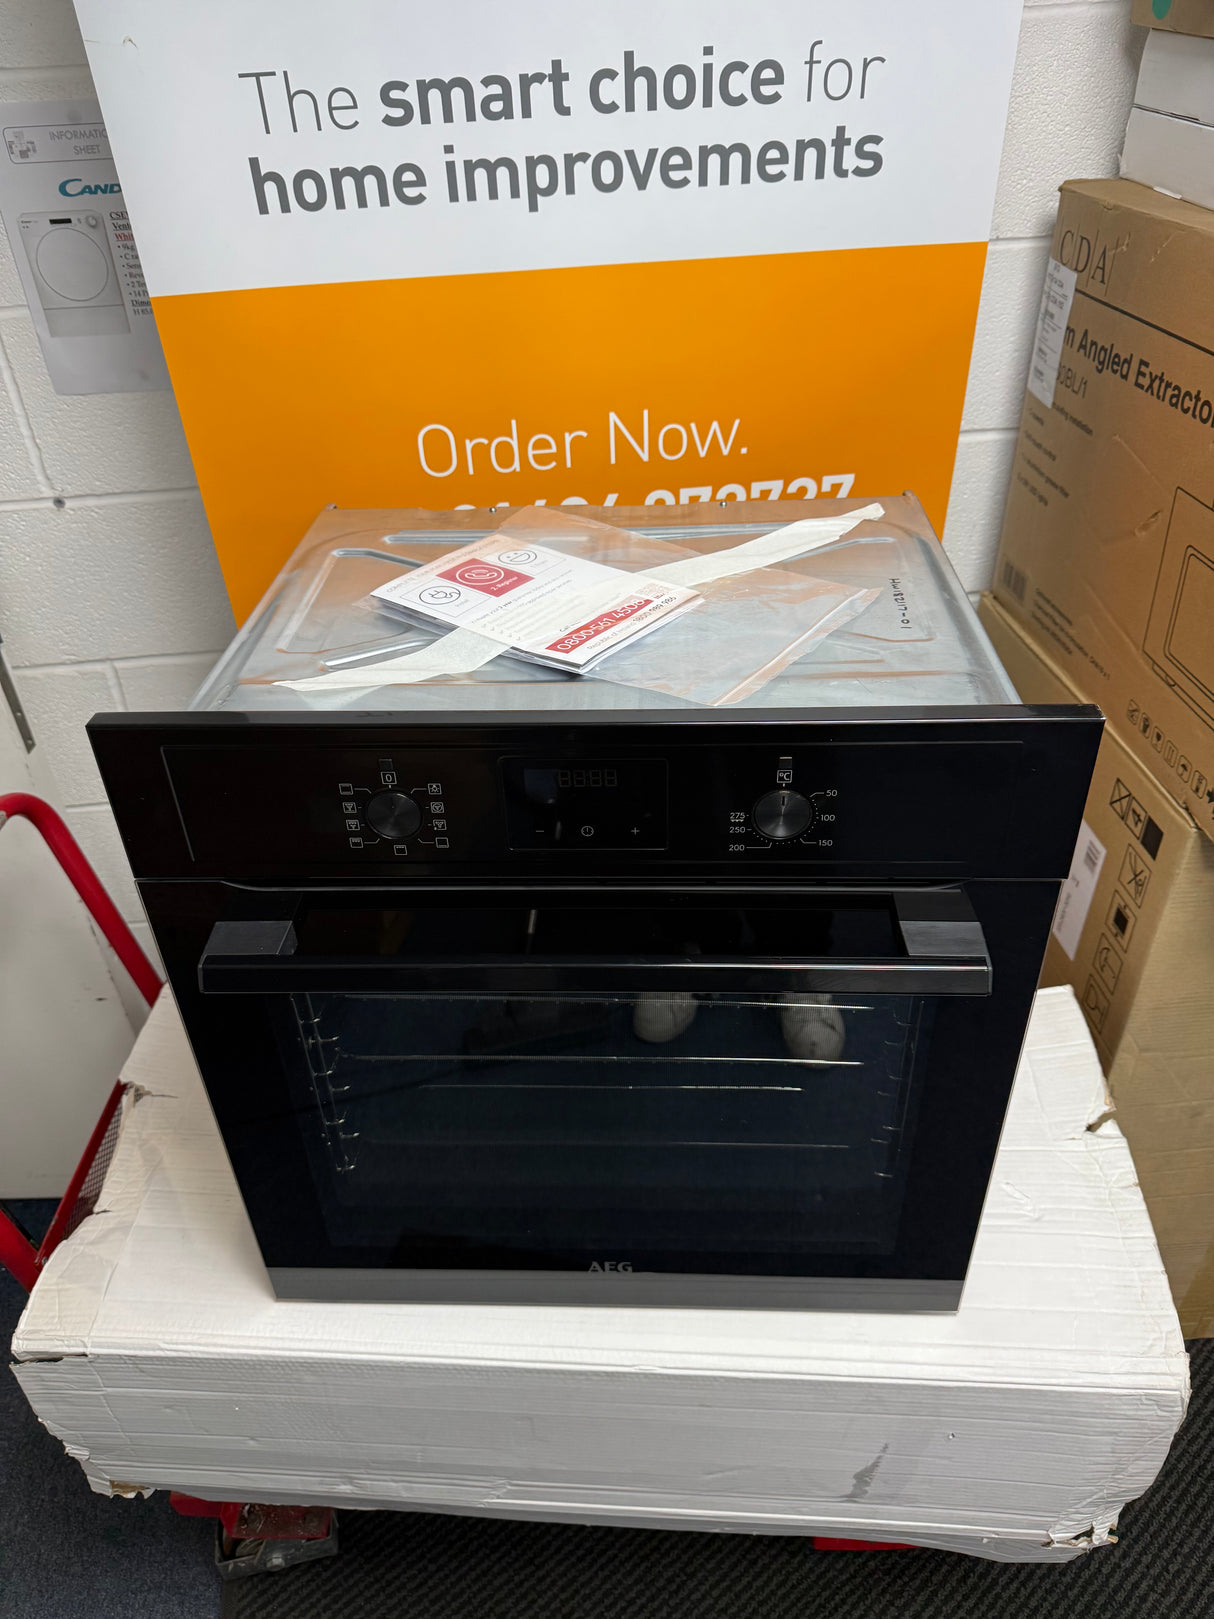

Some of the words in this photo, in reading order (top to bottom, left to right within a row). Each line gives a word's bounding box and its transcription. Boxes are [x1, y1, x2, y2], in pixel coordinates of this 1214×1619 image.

[237, 70, 361, 135] The
[380, 58, 572, 127] smart
[588, 45, 786, 114] choice
[803, 39, 887, 103] for
[49, 128, 108, 141] INFORMATIO
[73, 144, 101, 155] SHEET
[248, 156, 429, 216] home
[443, 125, 885, 213] improvements
[58, 178, 122, 197] CAND
[1059, 229, 1110, 285] CDA
[1077, 328, 1134, 382] Angled
[416, 419, 588, 478] Order
[608, 408, 749, 466] Now.
[826, 789, 838, 797] 50
[730, 812, 745, 820] 275
[821, 814, 836, 822] 100
[818, 839, 833, 847] 150
[587, 1260, 633, 1273] AEG
